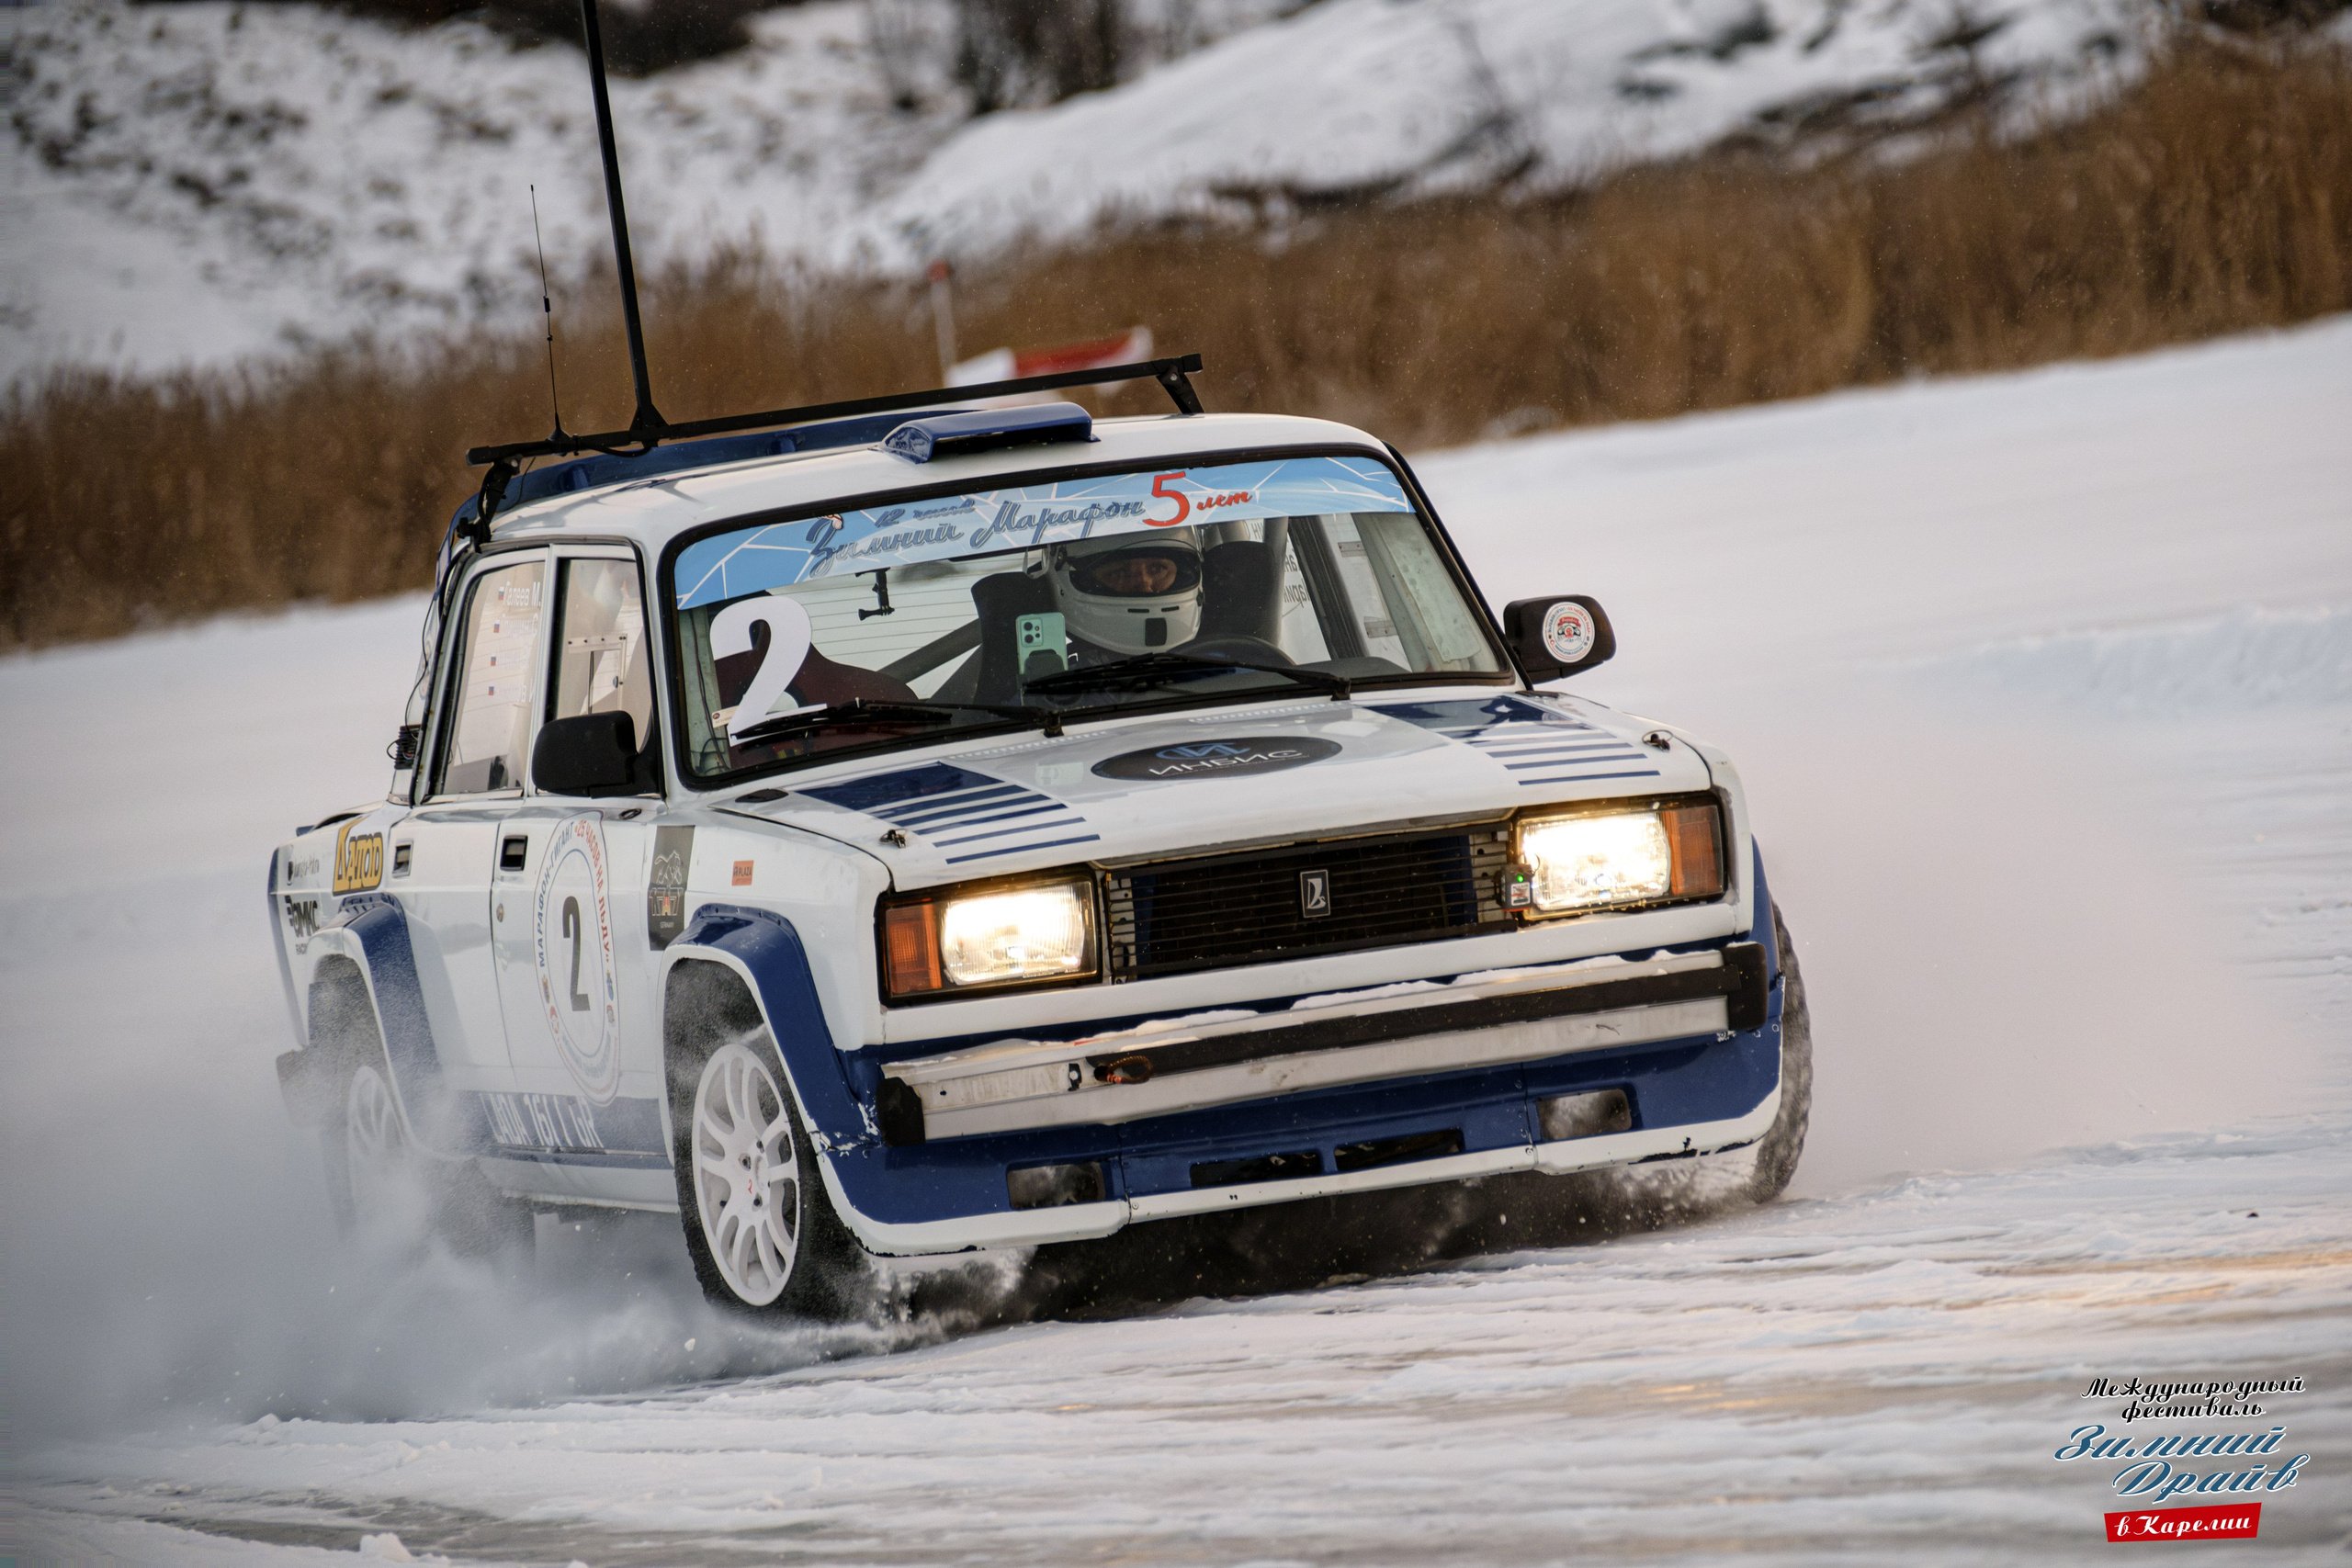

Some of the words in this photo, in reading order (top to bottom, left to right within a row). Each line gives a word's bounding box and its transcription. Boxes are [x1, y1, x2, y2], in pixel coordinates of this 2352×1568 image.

[874, 508, 905, 528] 12
[1142, 471, 1191, 527] 5
[1196, 491, 1253, 511] лет
[806, 517, 964, 578] Зимний
[969, 500, 1146, 548] Марафон
[709, 595, 827, 747] 2
[1148, 750, 1303, 775] ИНБИС
[537, 821, 575, 967] МАРАФОН-ГИГАНТ
[585, 824, 603, 867] ЧАСОВ
[596, 865, 604, 893] НА
[562, 896, 591, 1011] 2
